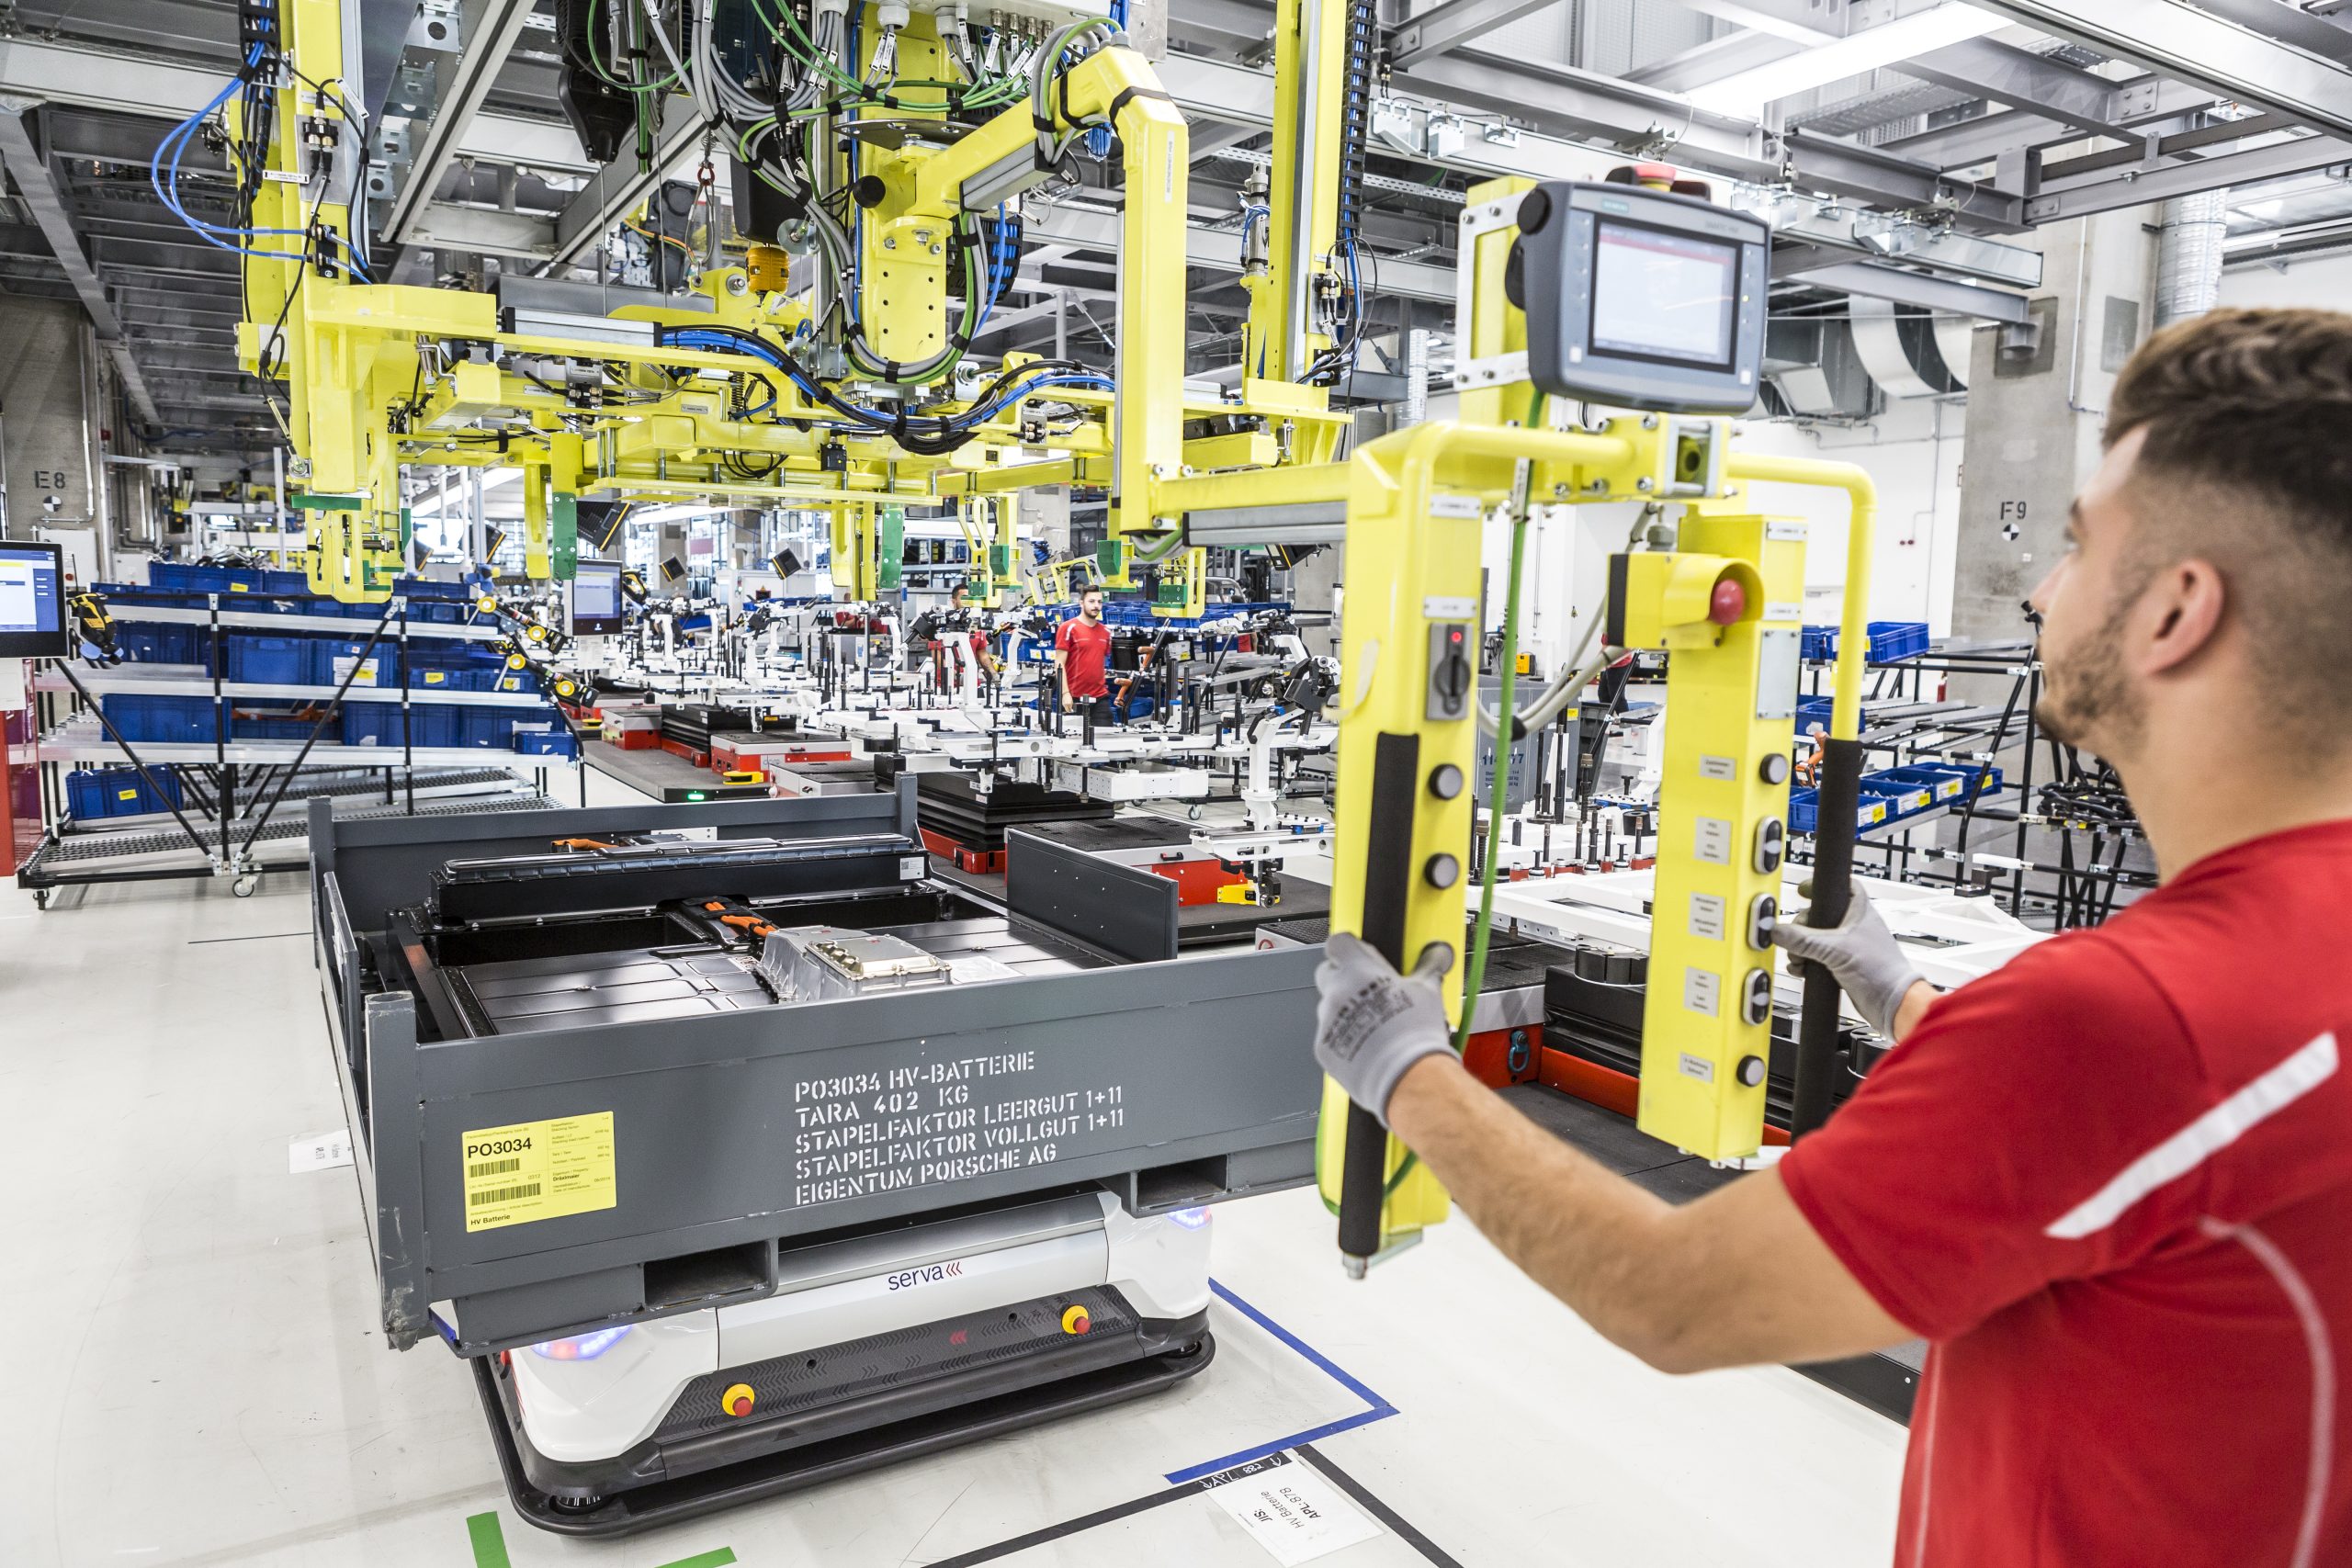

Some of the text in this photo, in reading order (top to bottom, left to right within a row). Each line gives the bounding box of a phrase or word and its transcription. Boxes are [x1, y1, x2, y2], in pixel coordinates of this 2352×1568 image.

[35, 470, 66, 490] E8
[2000, 501, 2027, 520] F9
[889, 1051, 1035, 1090] HV-BATTERIE
[796, 1085, 968, 1128] TARA 402 KG
[796, 1086, 1123, 1155] STAPELFAKTOR LEERGUT 1+11
[468, 1137, 532, 1158] PO3034
[796, 1108, 1125, 1180] STAPELFAKTOR VOLLGUT 1+11
[796, 1143, 1057, 1206] EIGENTUM PORSCHE AG
[482, 1214, 511, 1224] Batterie
[888, 1265, 944, 1291] serva
[1253, 1508, 1273, 1522] JIS:
[1261, 1491, 1305, 1529] HV Batterie
